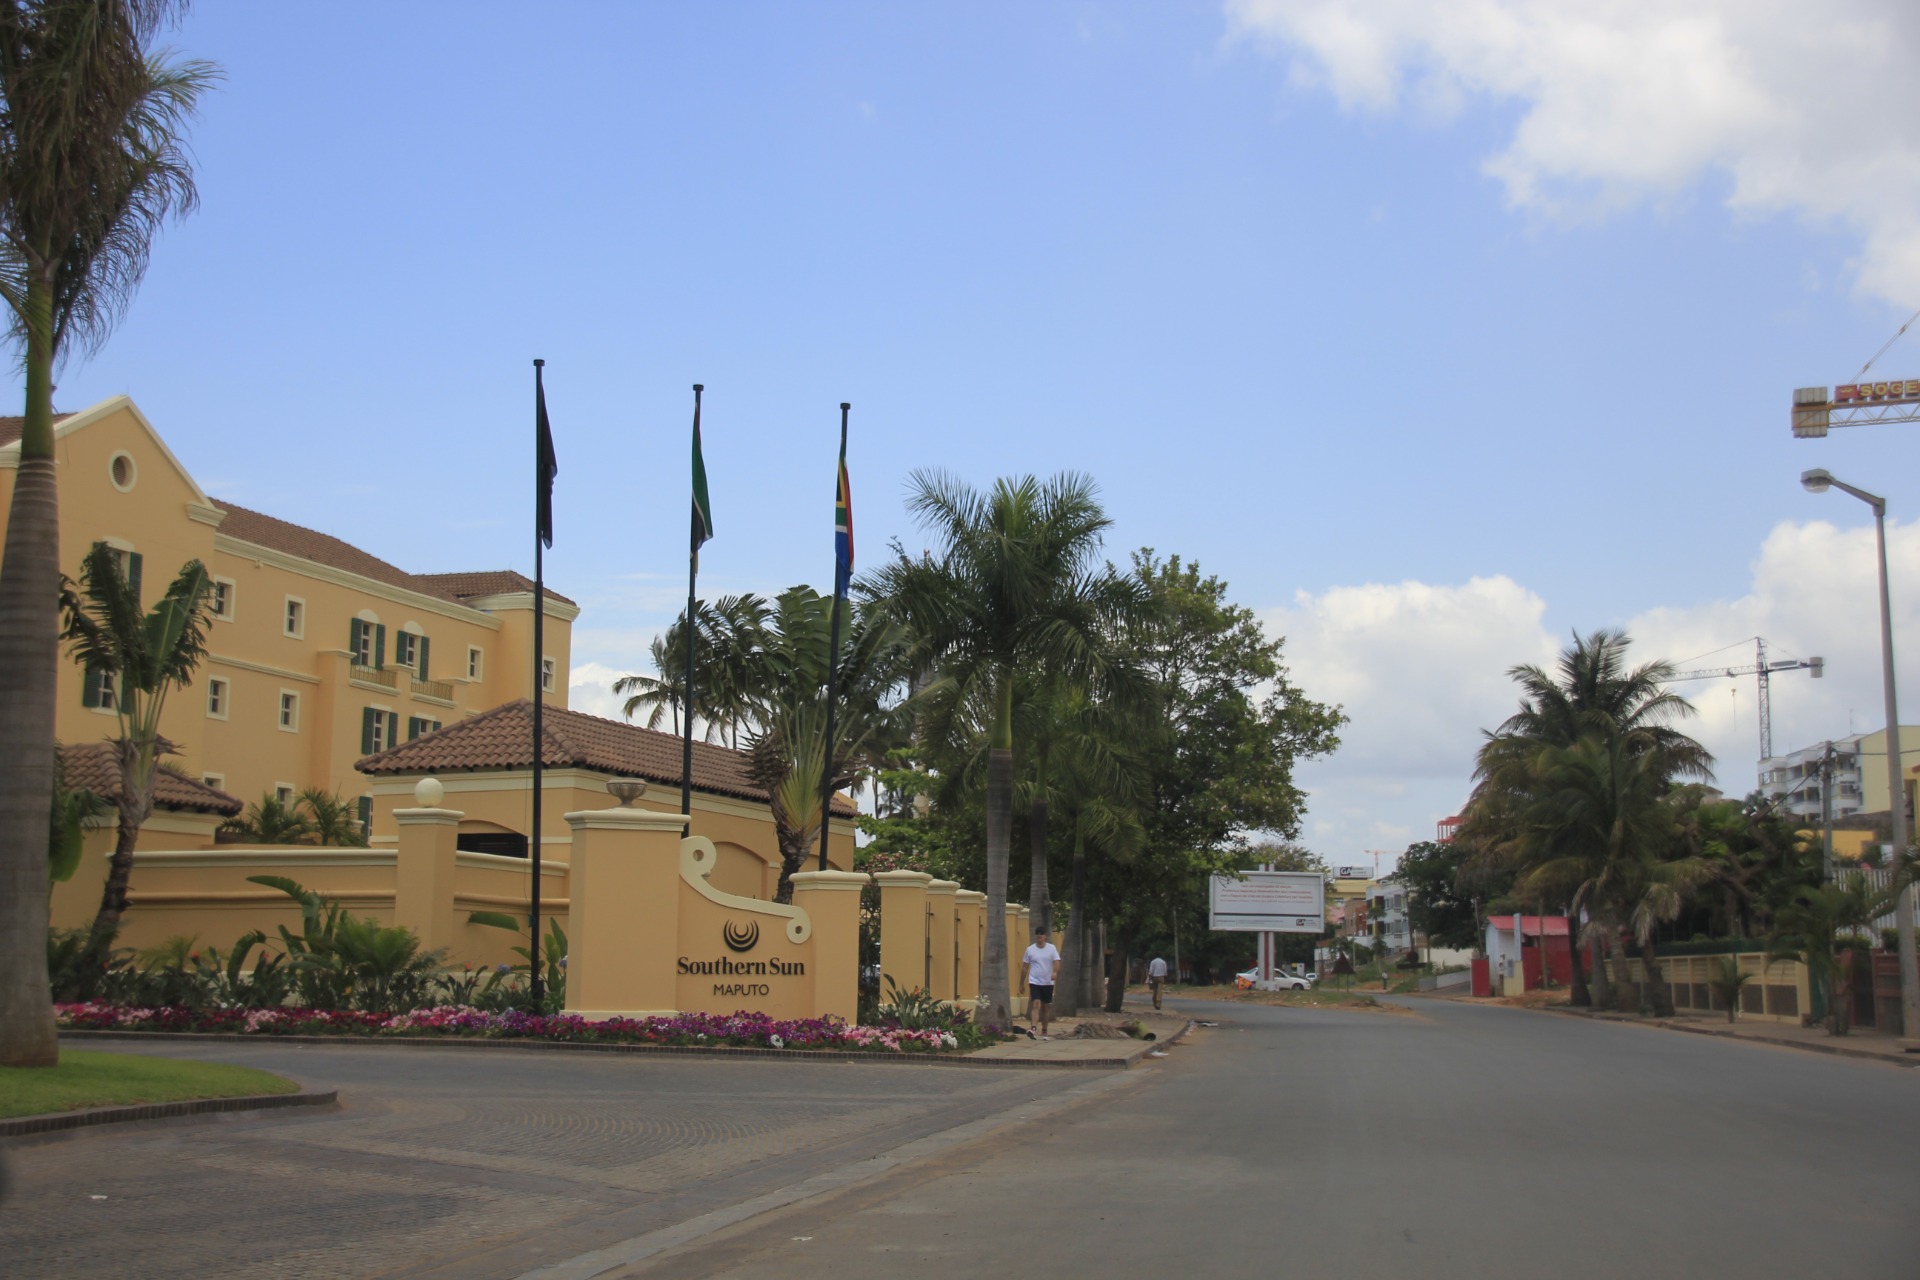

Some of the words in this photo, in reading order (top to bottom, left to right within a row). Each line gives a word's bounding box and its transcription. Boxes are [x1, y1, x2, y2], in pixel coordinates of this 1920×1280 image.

[677, 956, 766, 975] Southern
[769, 957, 805, 975] Sun
[713, 983, 770, 996] MAPUTO
